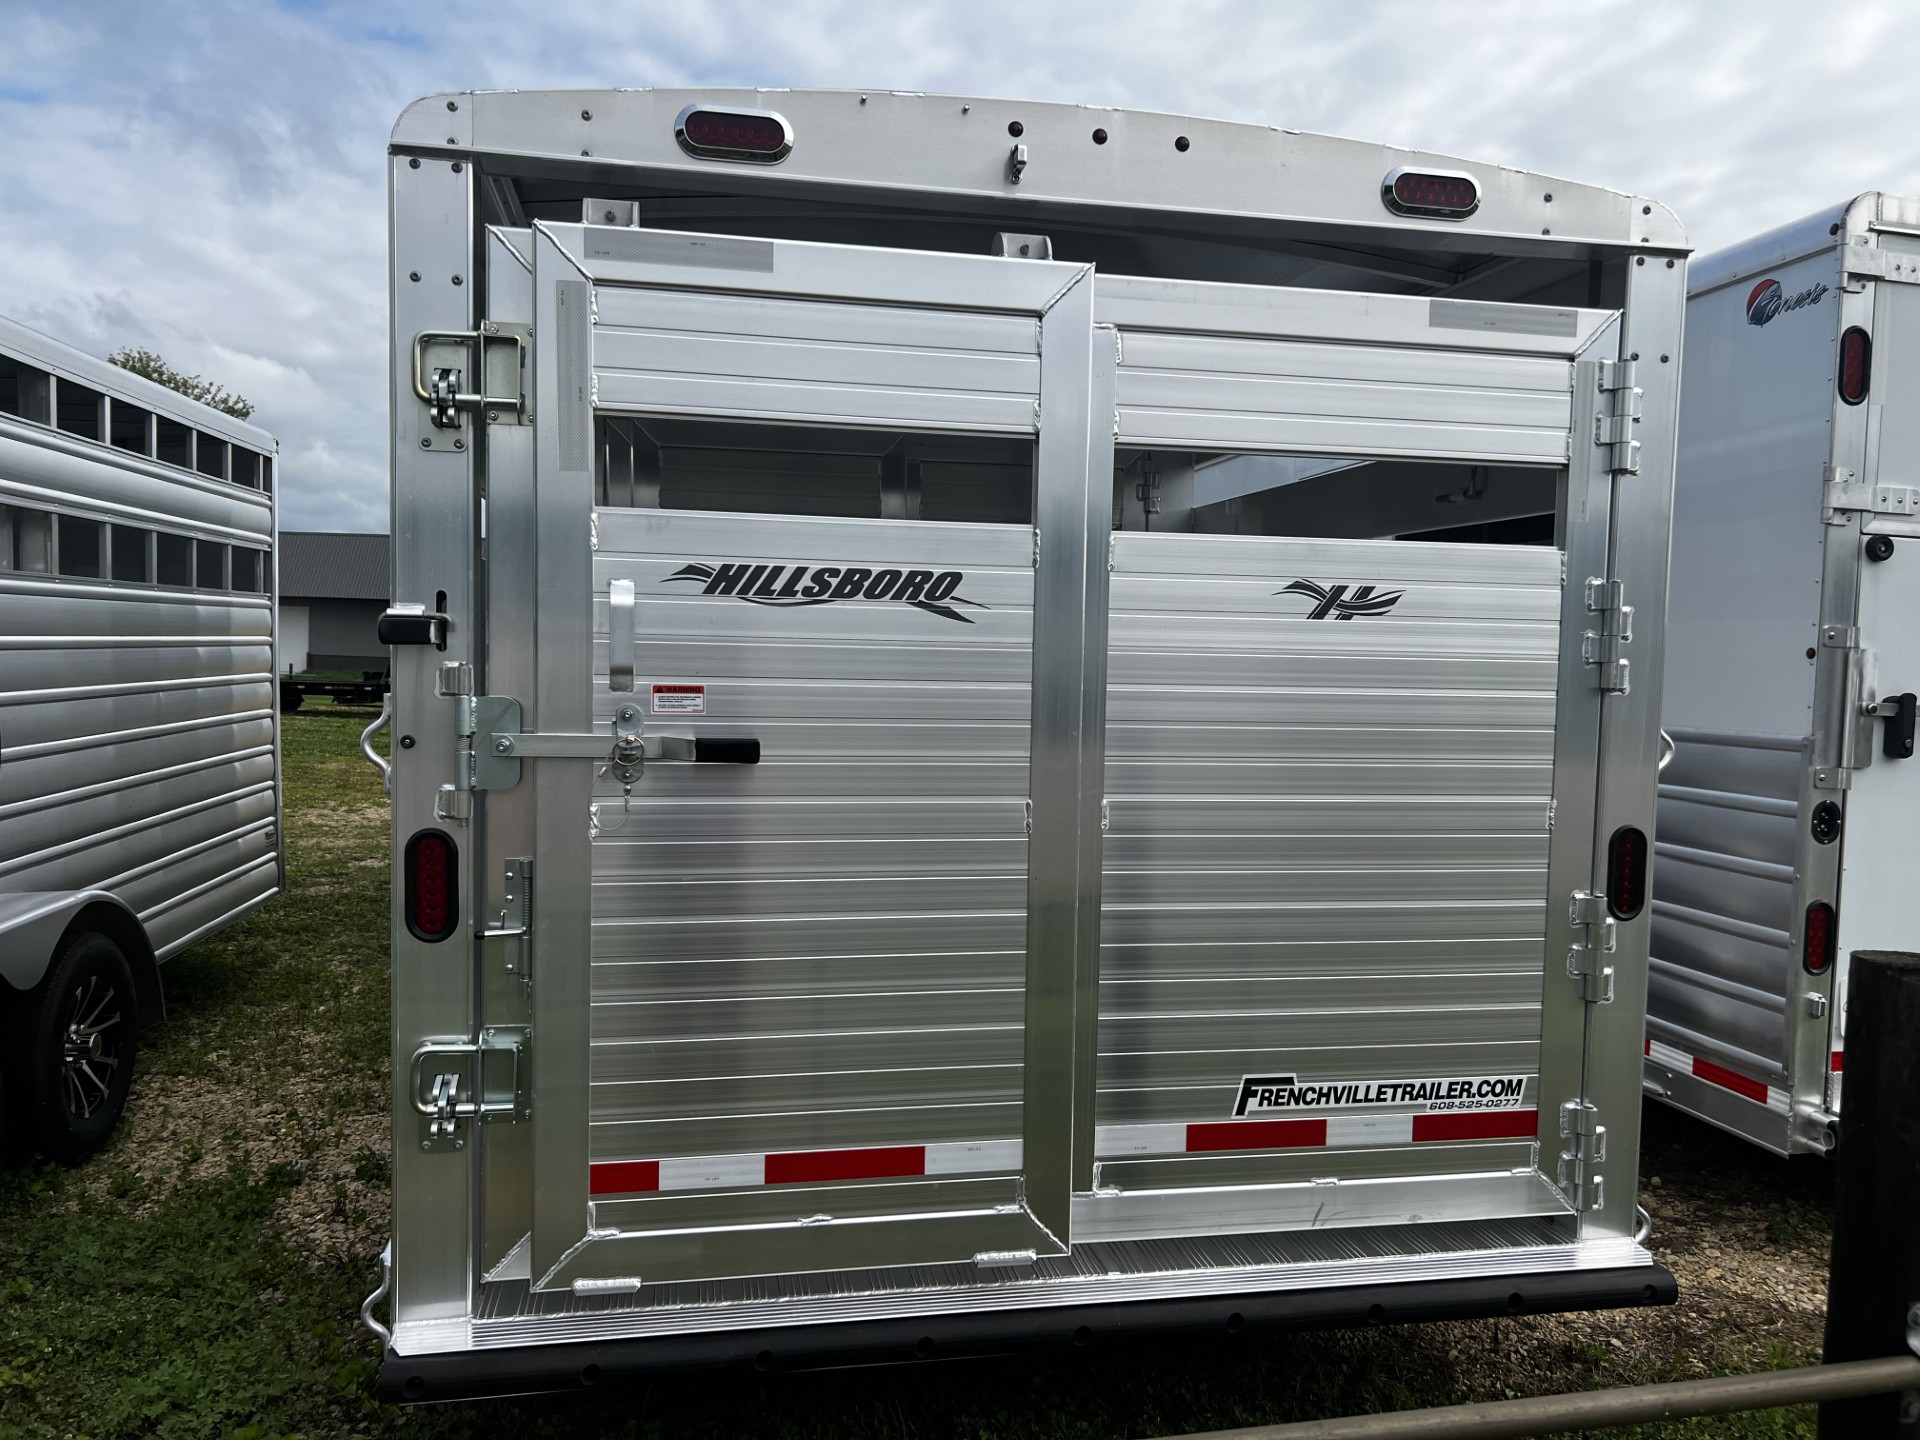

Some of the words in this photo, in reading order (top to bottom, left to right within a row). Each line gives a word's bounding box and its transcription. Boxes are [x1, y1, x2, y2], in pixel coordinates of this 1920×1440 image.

[702, 564, 963, 601] HILLSBORO
[1235, 1077, 1523, 1116] FRENCHVILLETRAILER.COM
[1429, 1099, 1519, 1110] 608-525-0277
